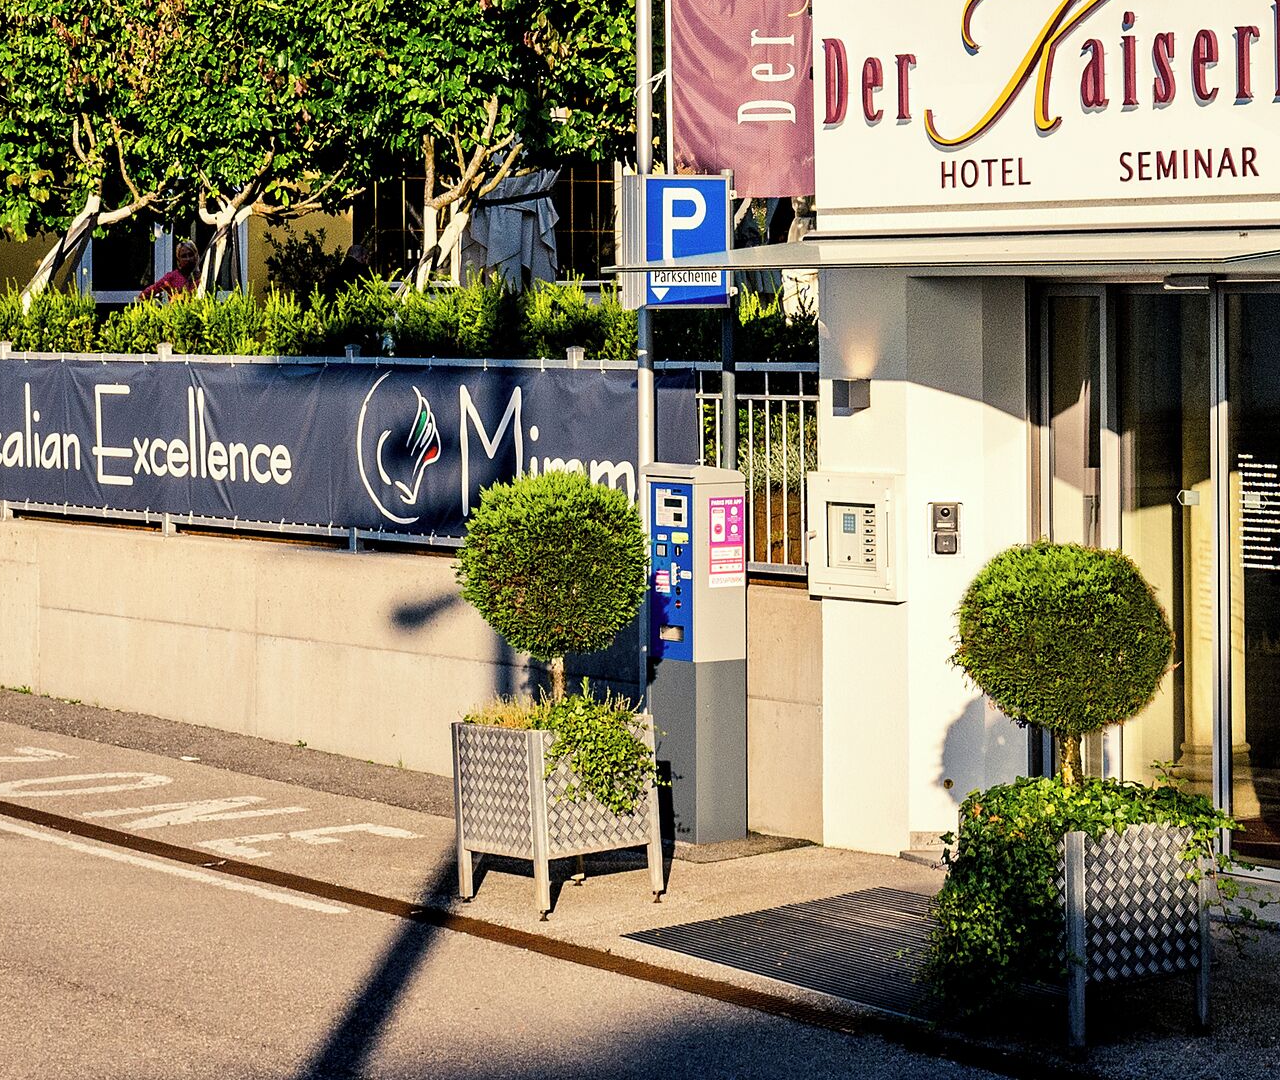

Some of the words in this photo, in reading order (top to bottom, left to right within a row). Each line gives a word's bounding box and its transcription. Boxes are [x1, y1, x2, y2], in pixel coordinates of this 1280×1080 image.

[736, 28, 797, 126] Der
[821, 37, 918, 128] Der
[940, 157, 1032, 189] HOTEL
[1119, 146, 1260, 182] SEMINAR
[662, 187, 707, 266] P
[653, 270, 718, 283] Parkscheine
[91, 383, 293, 486] Excellence
[459, 384, 637, 517] Mim
